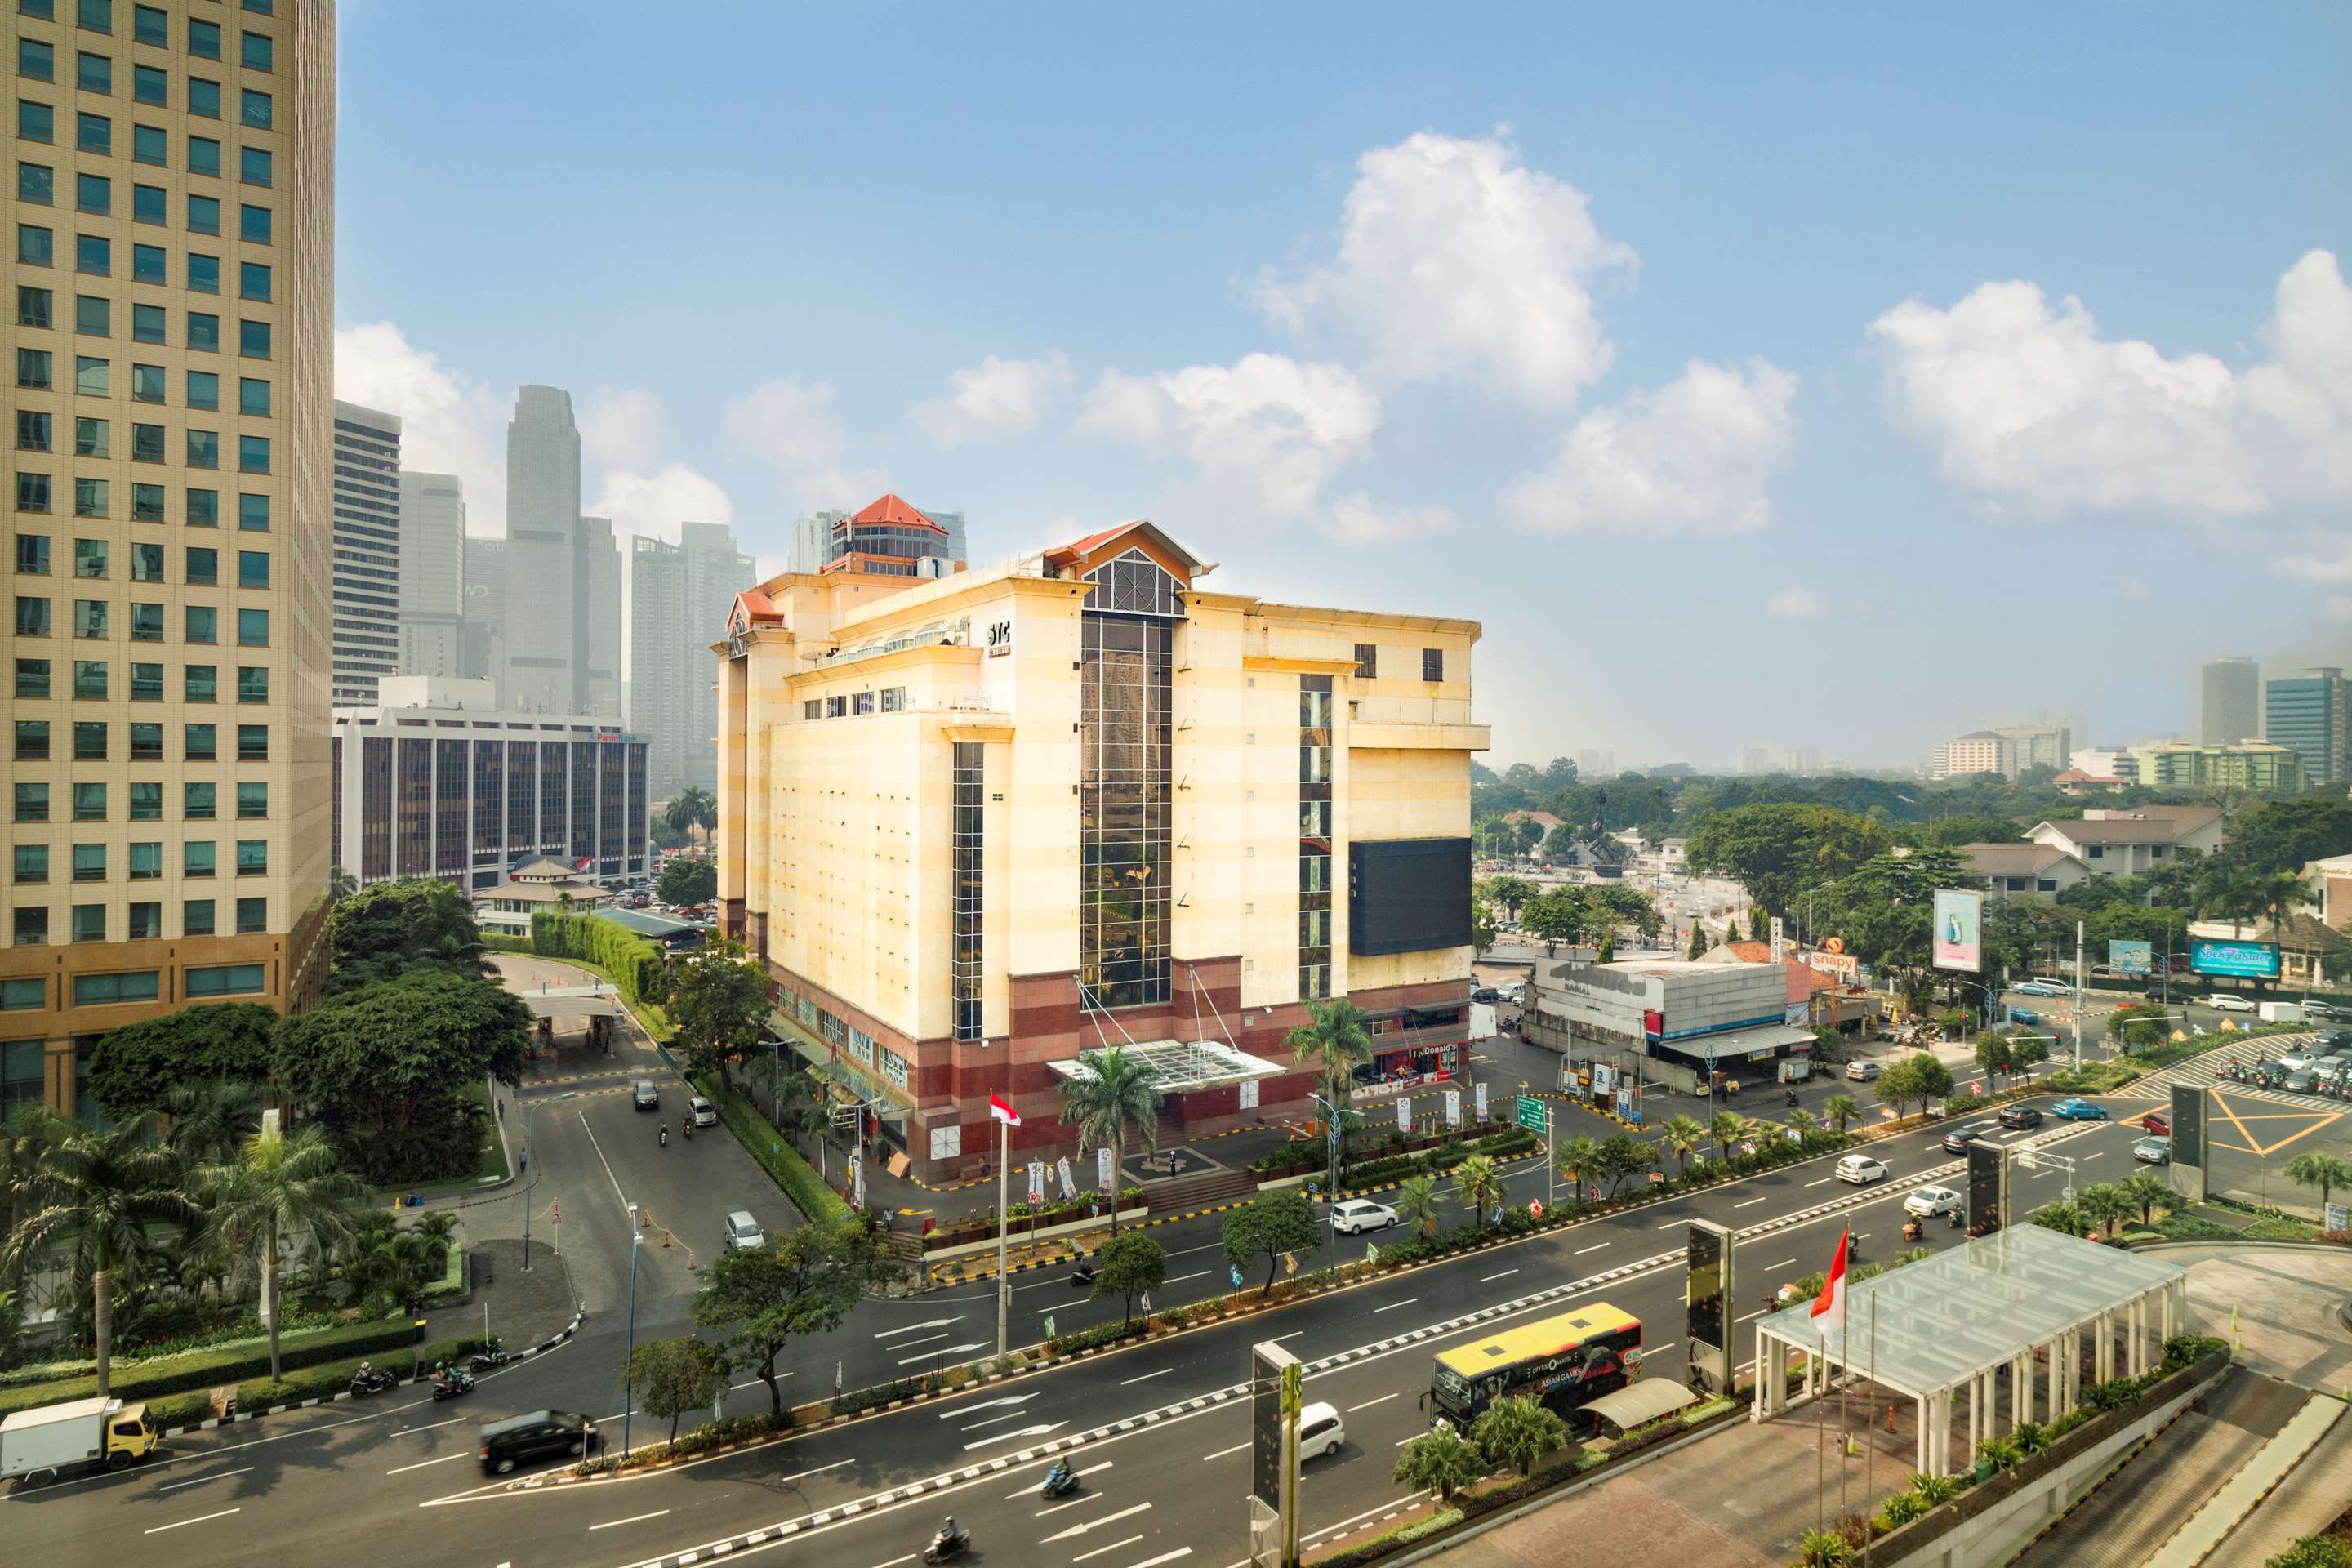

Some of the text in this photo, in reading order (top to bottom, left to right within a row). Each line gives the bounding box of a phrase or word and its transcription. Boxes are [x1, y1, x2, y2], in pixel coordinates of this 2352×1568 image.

[597, 733, 638, 742] PaninBank
[1813, 954, 1853, 970] snapy
[1541, 1368, 1582, 1388] ASIAN GAMES
